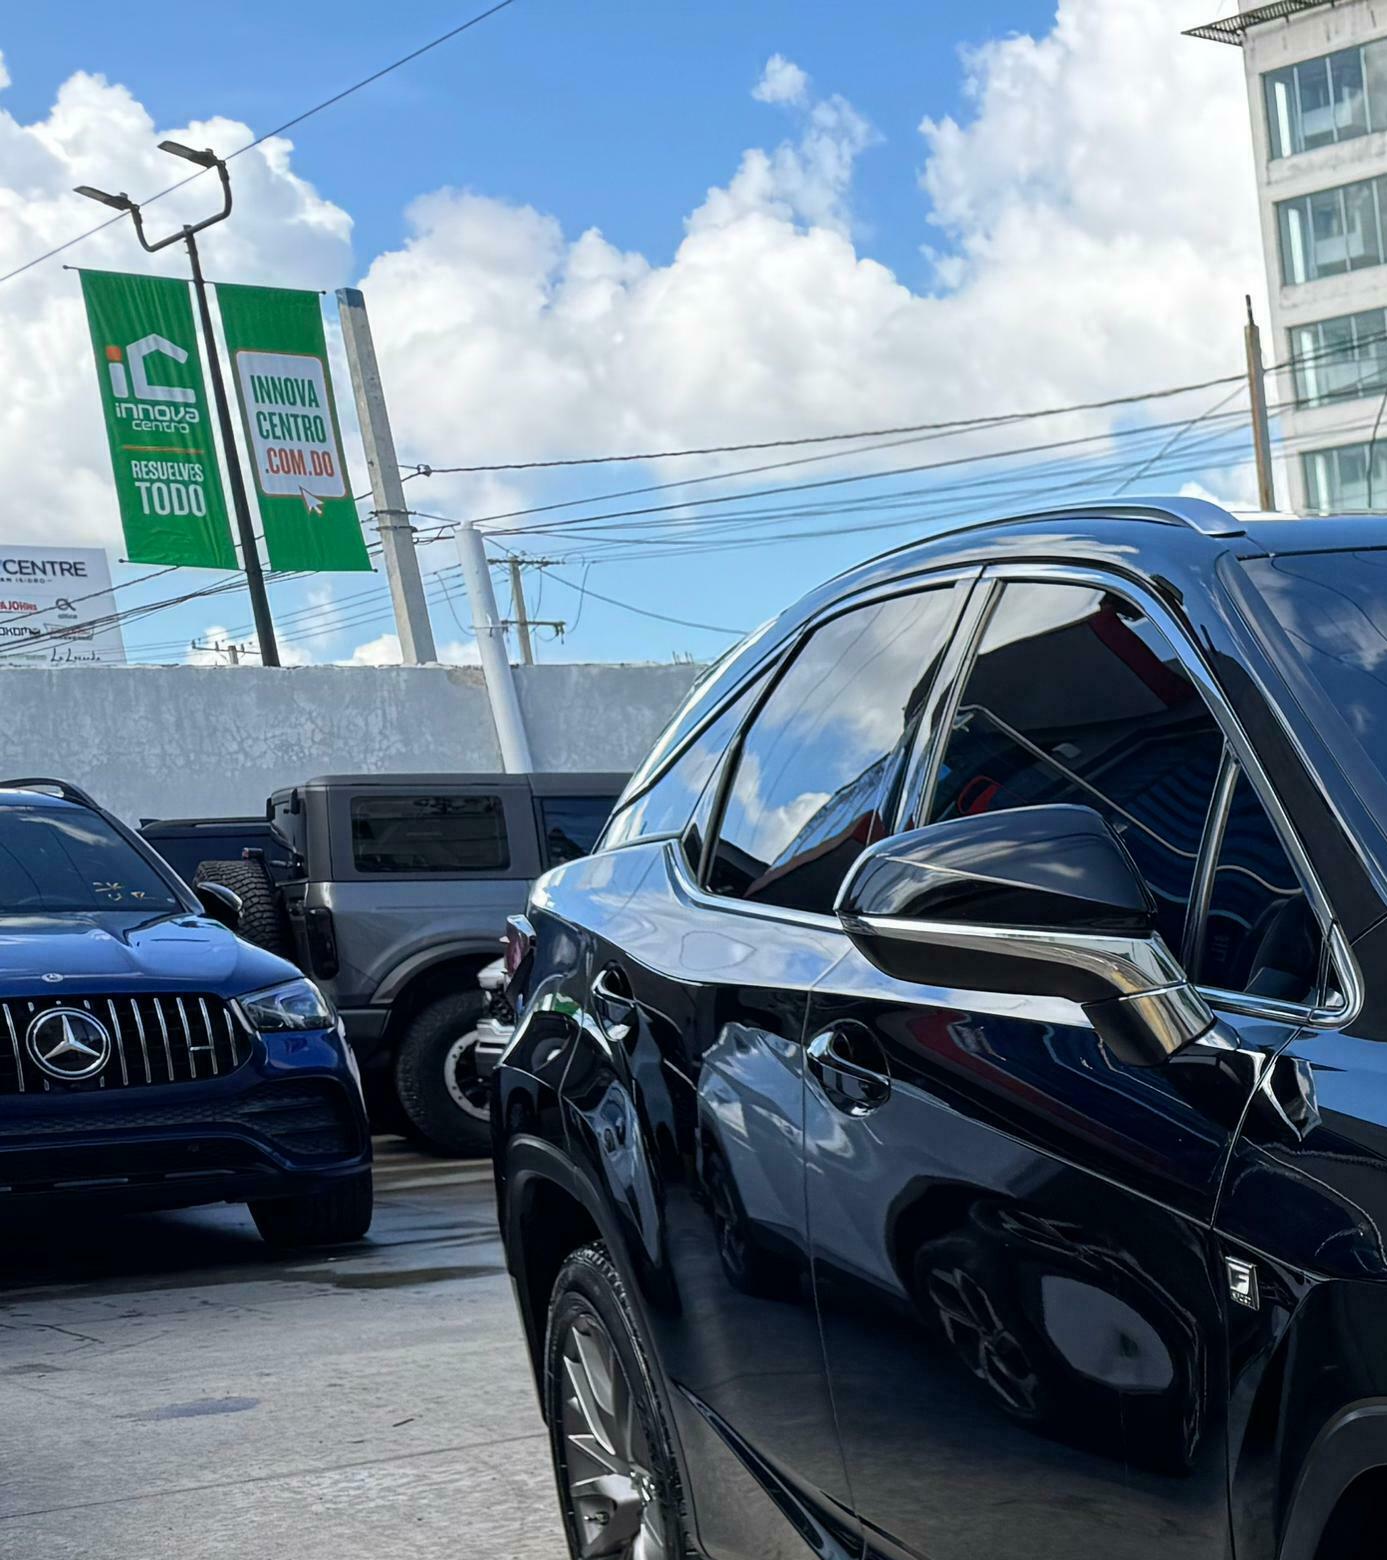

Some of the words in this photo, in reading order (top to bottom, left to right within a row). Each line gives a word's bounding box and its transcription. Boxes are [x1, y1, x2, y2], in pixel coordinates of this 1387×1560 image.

[250, 375, 320, 408] INNOVA
[116, 403, 199, 422] innova
[133, 421, 189, 433] centro
[257, 411, 326, 443] CENTRO
[131, 461, 204, 481] RESUELVES
[266, 448, 334, 477] .COM.DO
[136, 482, 206, 517] TODO
[0, 558, 87, 577] CENTRE
